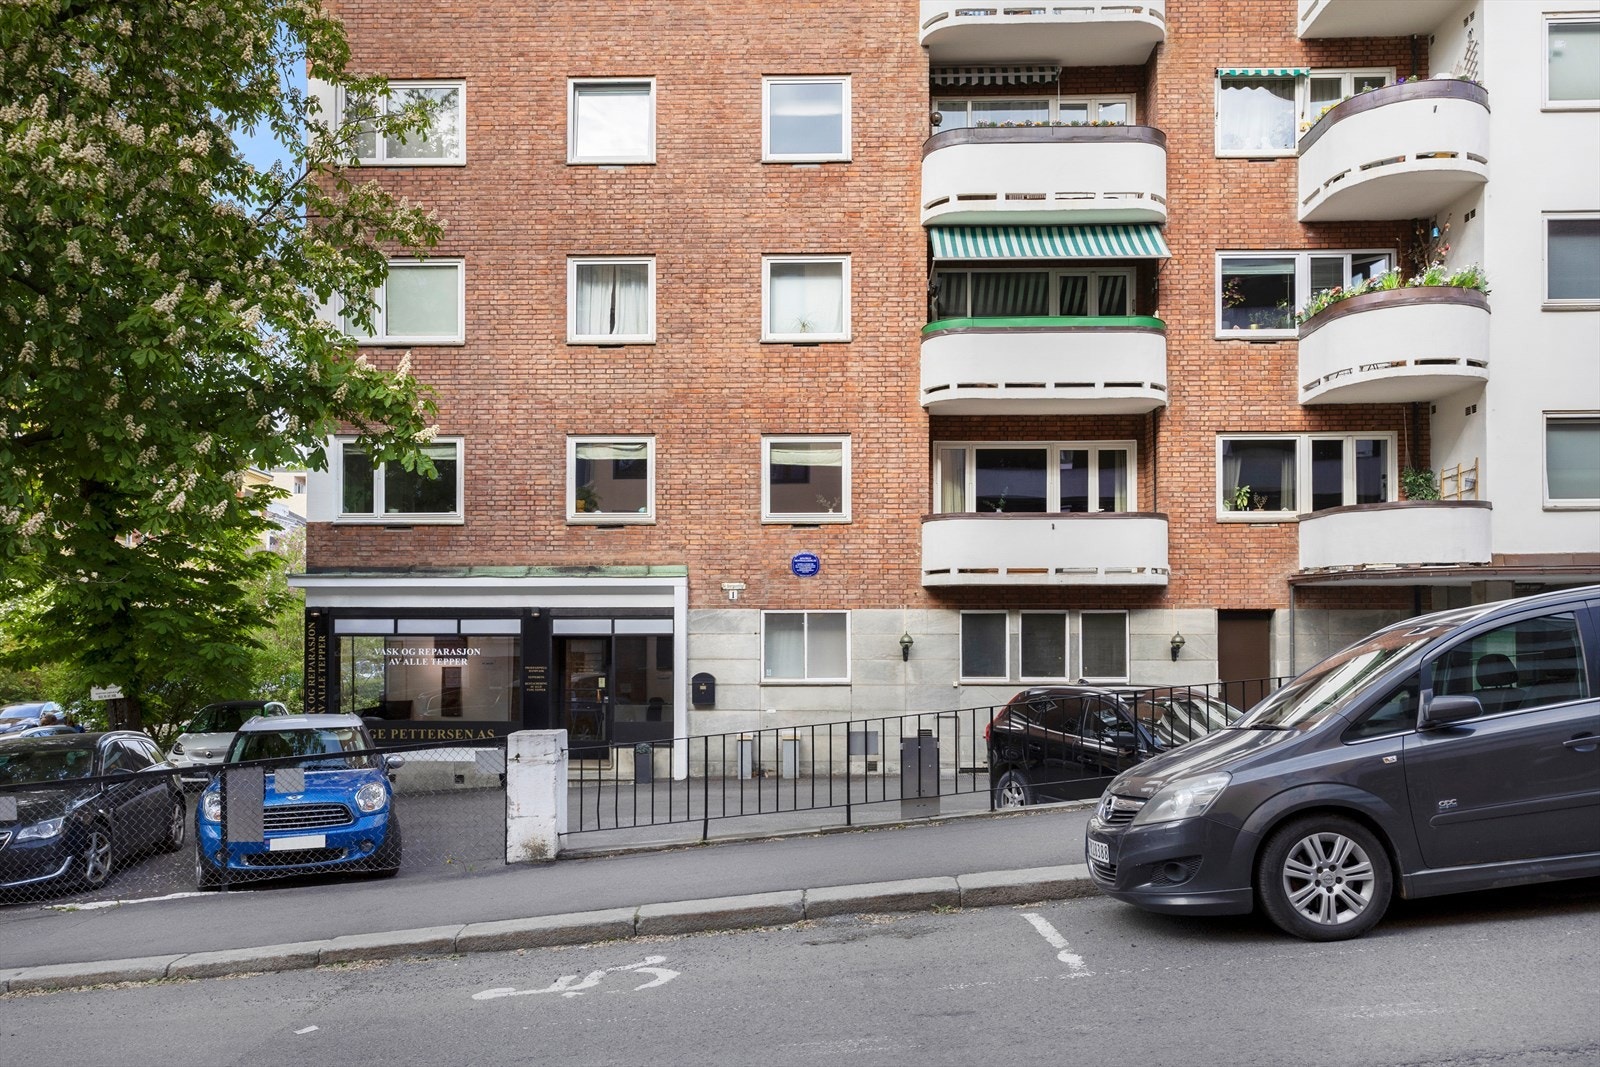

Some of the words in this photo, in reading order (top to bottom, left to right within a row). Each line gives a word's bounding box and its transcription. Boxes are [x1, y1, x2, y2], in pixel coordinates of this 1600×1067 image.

[308, 622, 316, 686] REPARASJON
[318, 635, 326, 674] TEPPER
[374, 648, 399, 656] VASK
[401, 648, 416, 656] OG
[418, 647, 481, 656] REPARASJON
[389, 657, 402, 666] AV
[403, 657, 429, 666] ALLE
[431, 657, 468, 666] TEPPER
[308, 689, 316, 704] OG
[318, 676, 326, 702] ALLE
[368, 728, 386, 739] GE
[391, 728, 473, 739] PETTERSEN
[478, 728, 495, 739] AS
